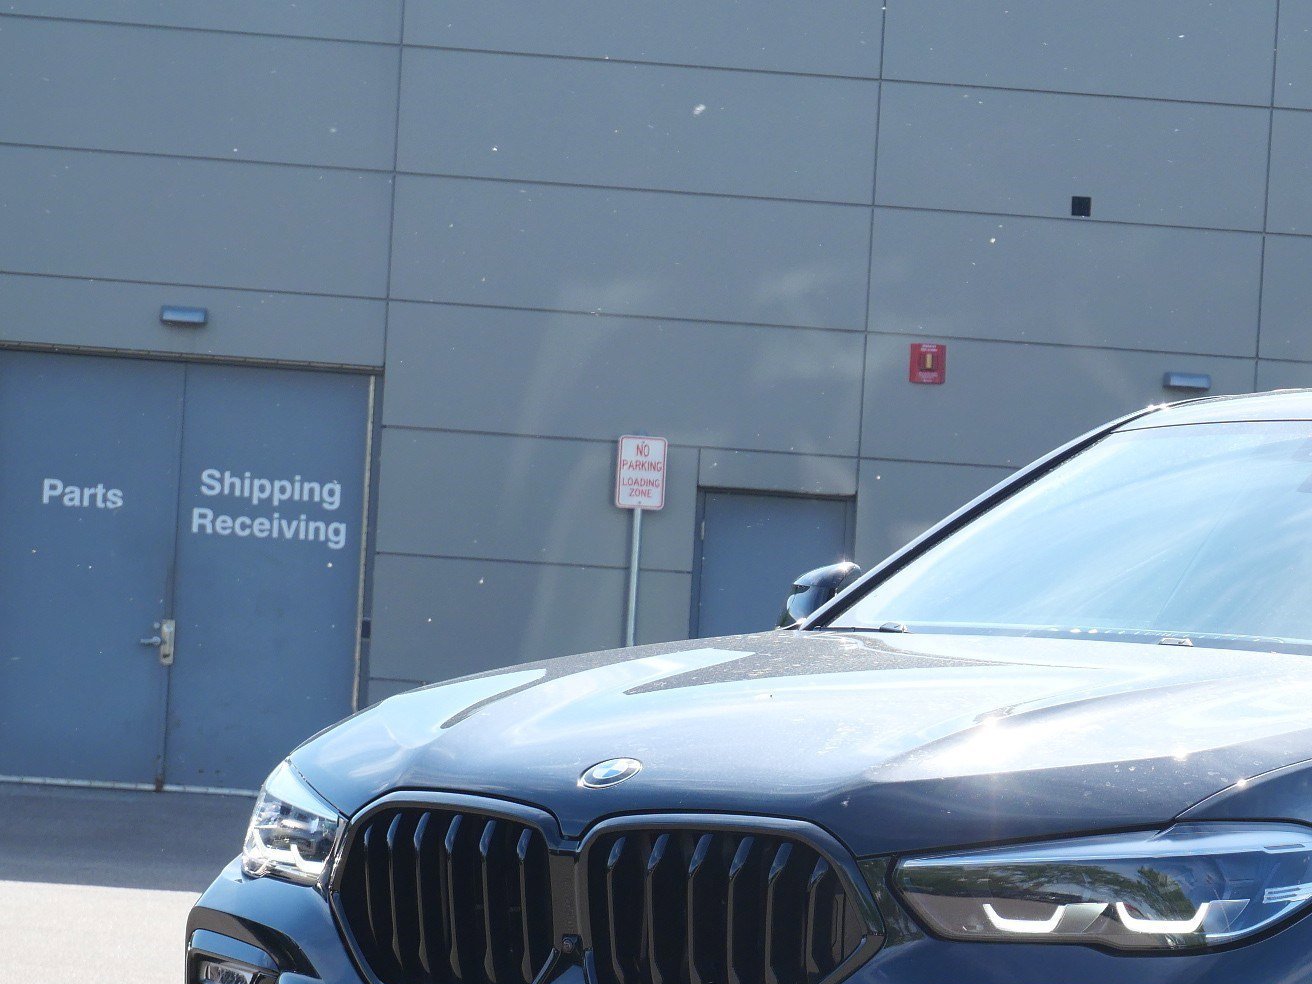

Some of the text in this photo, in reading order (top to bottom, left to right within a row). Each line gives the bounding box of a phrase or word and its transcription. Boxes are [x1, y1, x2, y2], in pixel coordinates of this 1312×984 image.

[636, 444, 650, 457] NO
[622, 460, 662, 472] PARKING
[622, 477, 660, 488] LOADING
[42, 478, 124, 509] Parts
[200, 468, 342, 511] Shipping
[629, 488, 652, 498] ZONE
[191, 507, 347, 550] Receiving
